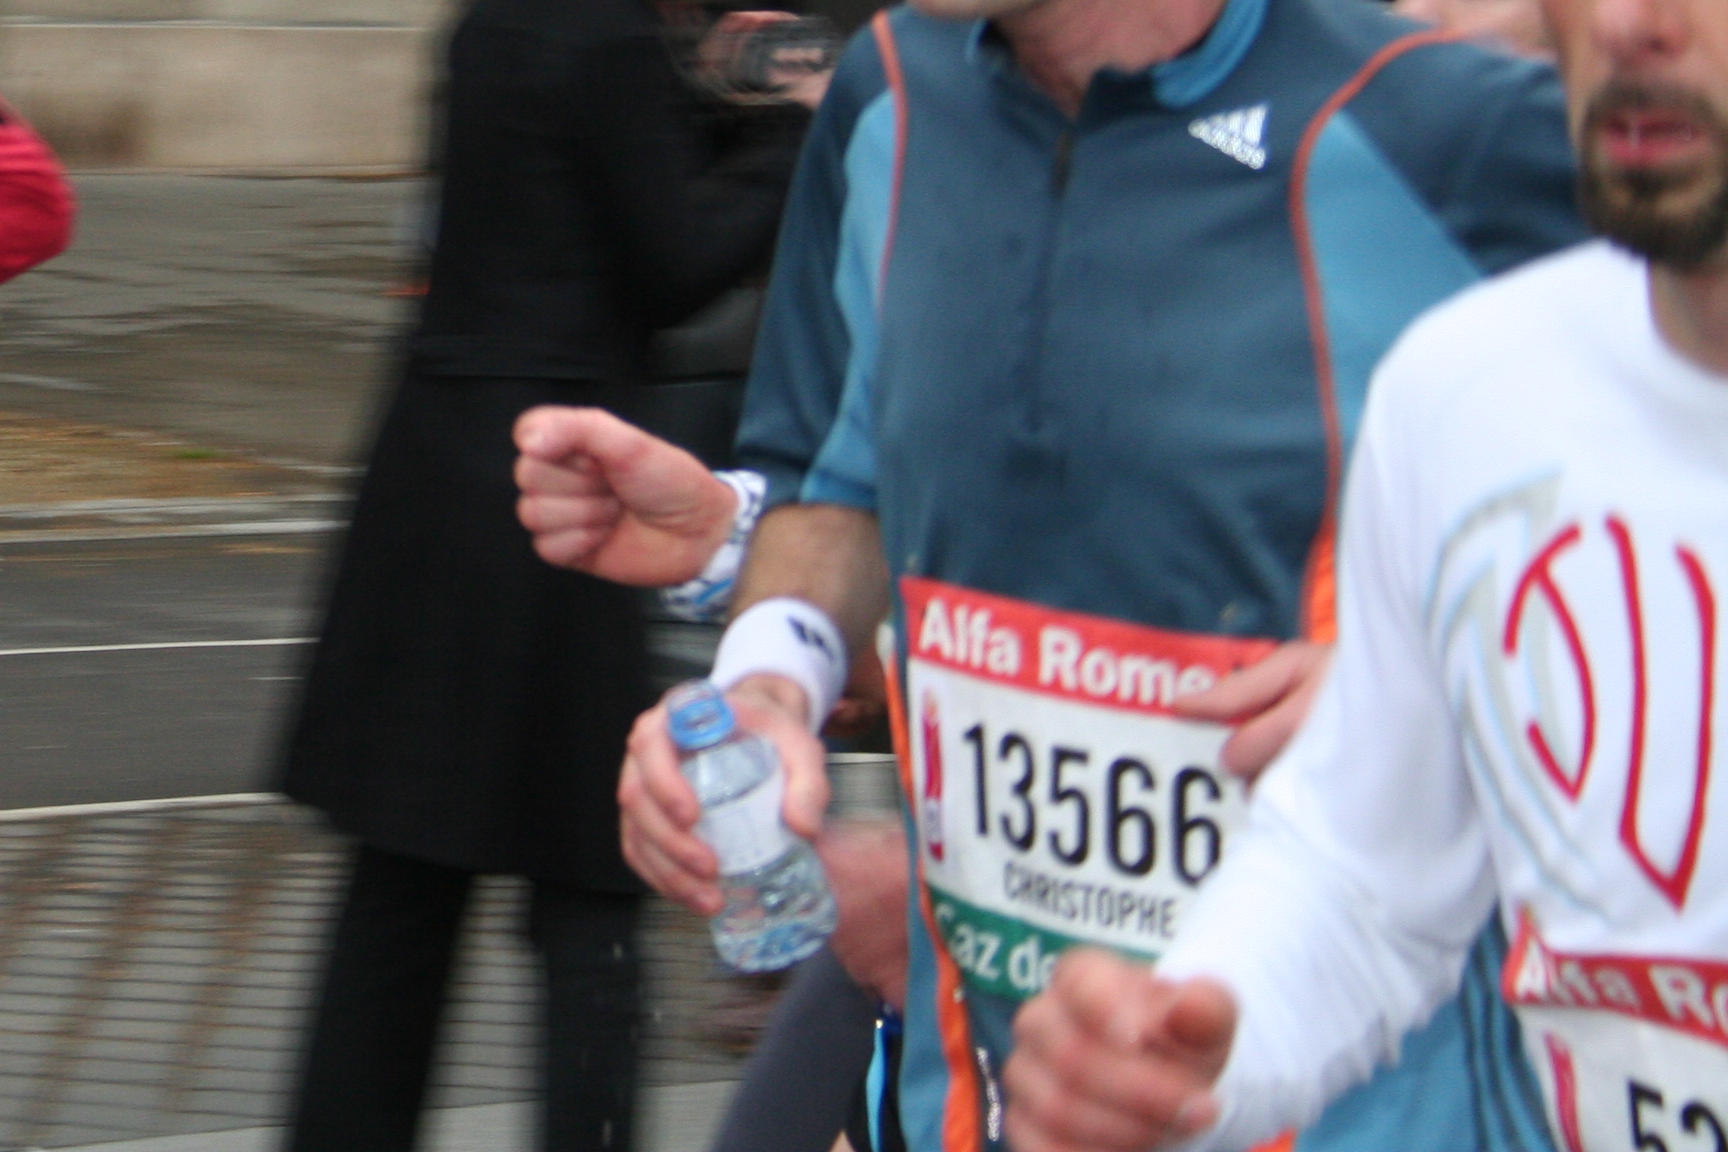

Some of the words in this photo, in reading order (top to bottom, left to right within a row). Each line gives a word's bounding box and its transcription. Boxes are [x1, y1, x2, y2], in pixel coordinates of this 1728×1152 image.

[918, 596, 1021, 678] Alfa
[962, 723, 1223, 888] 13566
[1003, 861, 1176, 940] CHRISTOPHE
